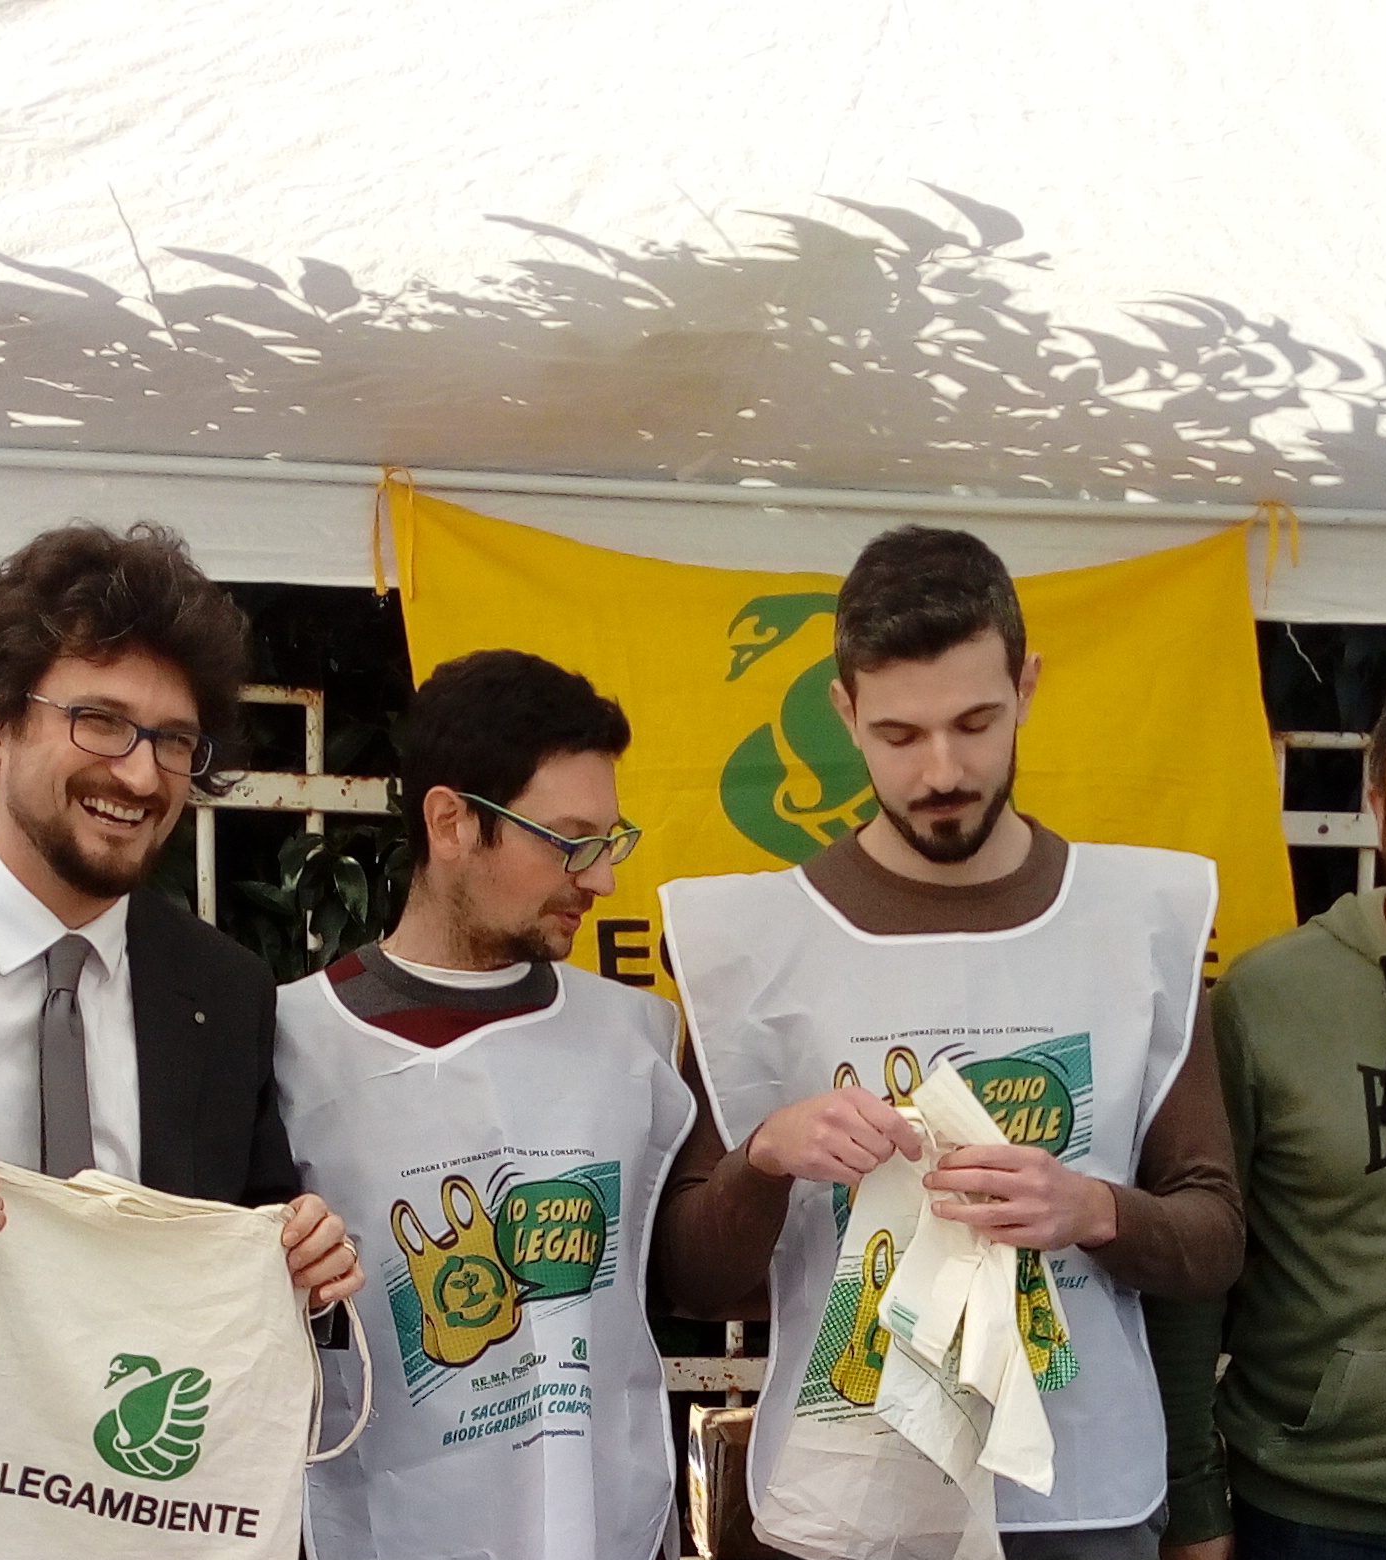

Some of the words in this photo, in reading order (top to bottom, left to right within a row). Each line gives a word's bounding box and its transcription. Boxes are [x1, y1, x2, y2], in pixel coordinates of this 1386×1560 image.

[982, 1075, 1047, 1106] SONO
[990, 1106, 1063, 1144] GALE
[507, 1198, 528, 1224] IO
[535, 1198, 593, 1224] SONO
